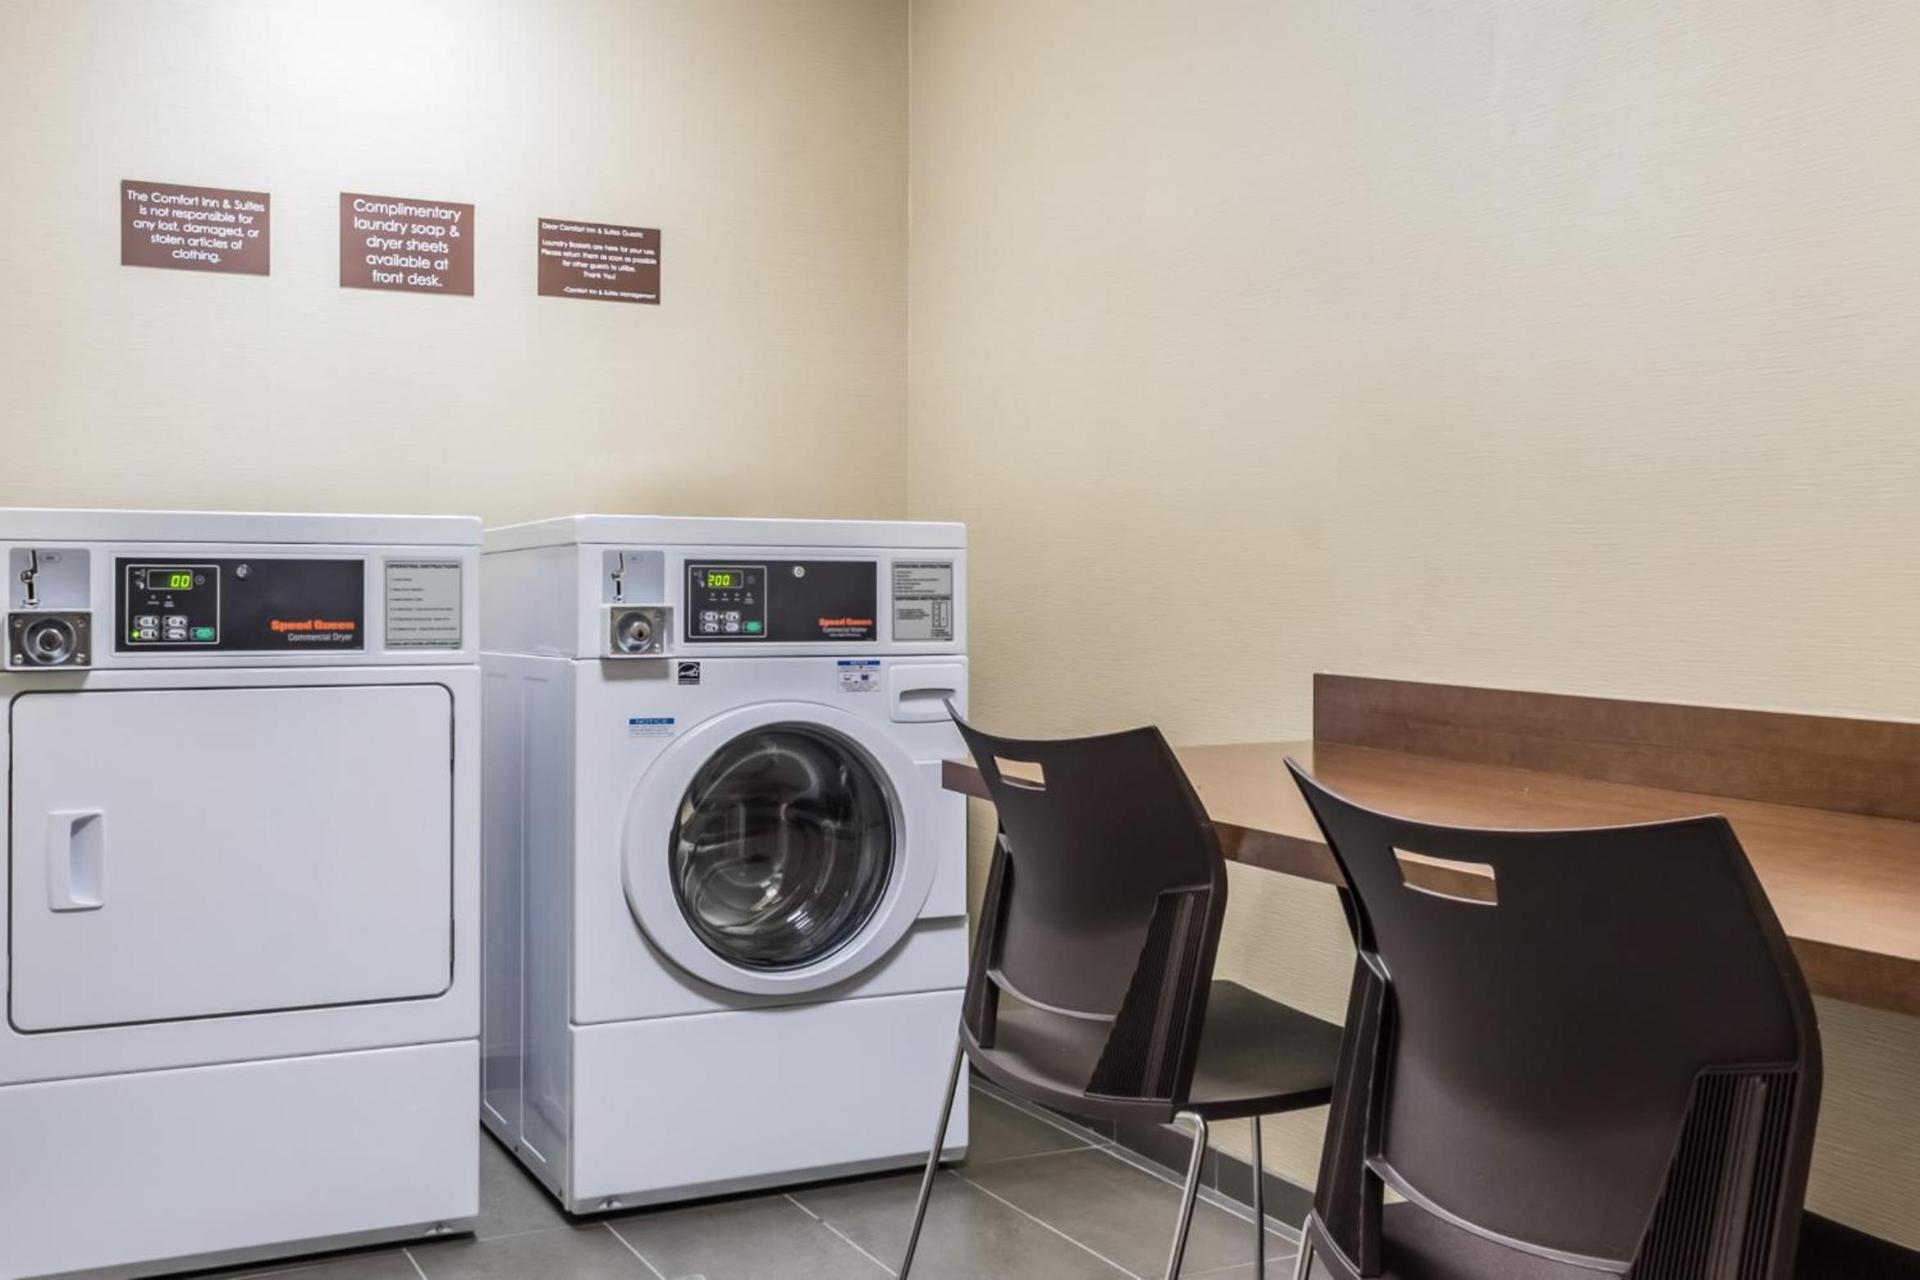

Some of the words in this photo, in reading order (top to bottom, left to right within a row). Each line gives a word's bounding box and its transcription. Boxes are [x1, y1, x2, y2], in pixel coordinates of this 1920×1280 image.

[127, 190, 148, 202] The
[151, 192, 199, 206] Comfort
[202, 197, 219, 208] Inn
[223, 199, 231, 209] &
[234, 200, 265, 212] Suites
[139, 205, 147, 215] is
[150, 207, 169, 216] not
[172, 209, 235, 222] responsible
[238, 214, 253, 224] for
[353, 199, 461, 222] Complimentary
[133, 220, 155, 231] any
[158, 220, 180, 231] lost,
[183, 223, 244, 237] damaged,
[247, 229, 259, 238] or
[354, 217, 408, 234] laundry
[411, 224, 445, 237] soap
[450, 225, 460, 237] &
[559, 224, 585, 232] Comfort
[603, 228, 620, 236] Suites
[151, 234, 184, 245] stolen
[187, 237, 228, 248] articles
[231, 240, 243, 250] of
[366, 235, 403, 251] dryer
[406, 239, 448, 253] sheets
[542, 240, 568, 248] Laundry
[172, 249, 221, 263] clothing.
[541, 248, 561, 256] Please
[366, 254, 431, 269] available
[434, 258, 449, 270] at
[372, 270, 404, 283] front
[407, 273, 443, 287] desk.
[171, 575, 191, 587] 00
[708, 575, 729, 586] 200
[271, 620, 312, 632] Speed
[314, 620, 355, 630] Queen
[819, 618, 845, 628] Speed
[846, 618, 873, 626] Queen
[287, 633, 331, 641] Commercial
[333, 633, 353, 641] Dryer
